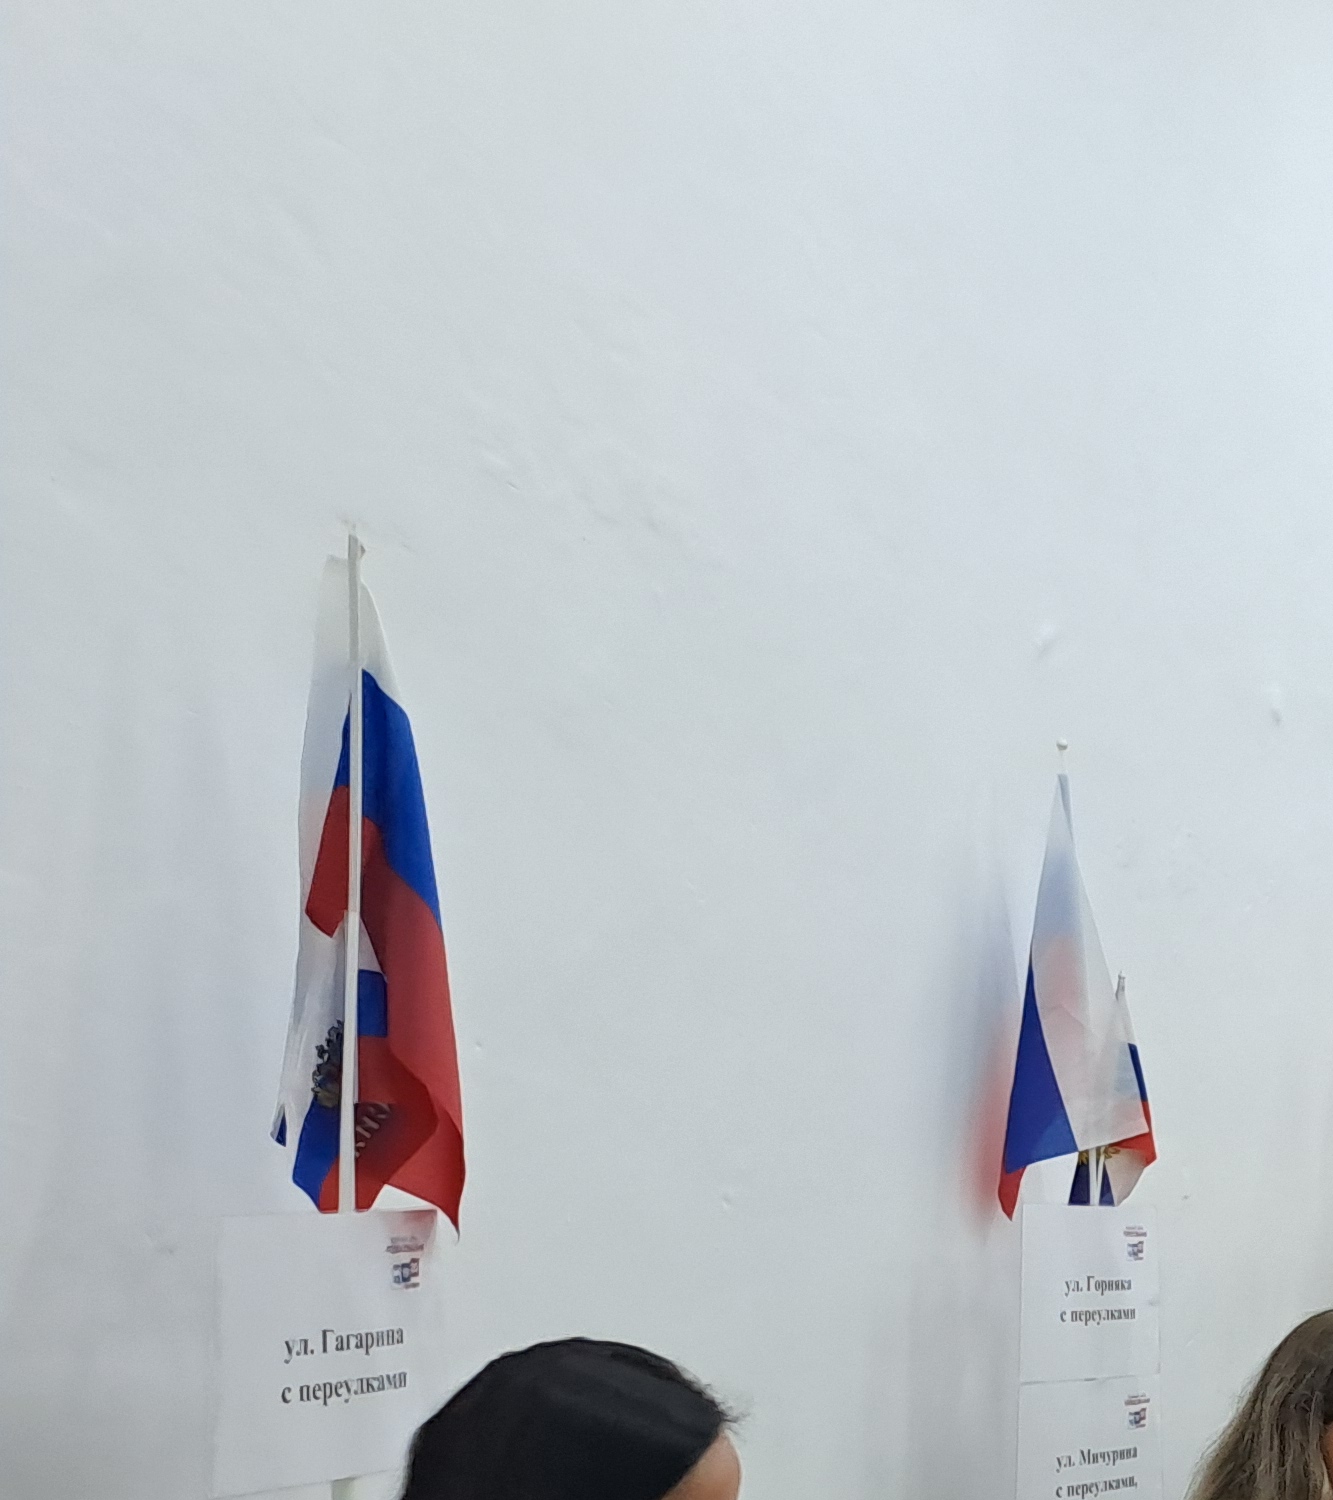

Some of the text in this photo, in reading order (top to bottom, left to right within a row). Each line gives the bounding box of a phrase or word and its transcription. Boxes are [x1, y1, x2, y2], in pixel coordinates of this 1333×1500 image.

[1065, 1276, 1131, 1296] ул. Горняка
[1060, 1309, 1135, 1326] с переулками
[284, 1328, 403, 1364] ул. Гагарина
[281, 1372, 407, 1406] с переулками
[1056, 1447, 1137, 1473] ул. Мичурина
[1056, 1487, 1062, 1498] с
